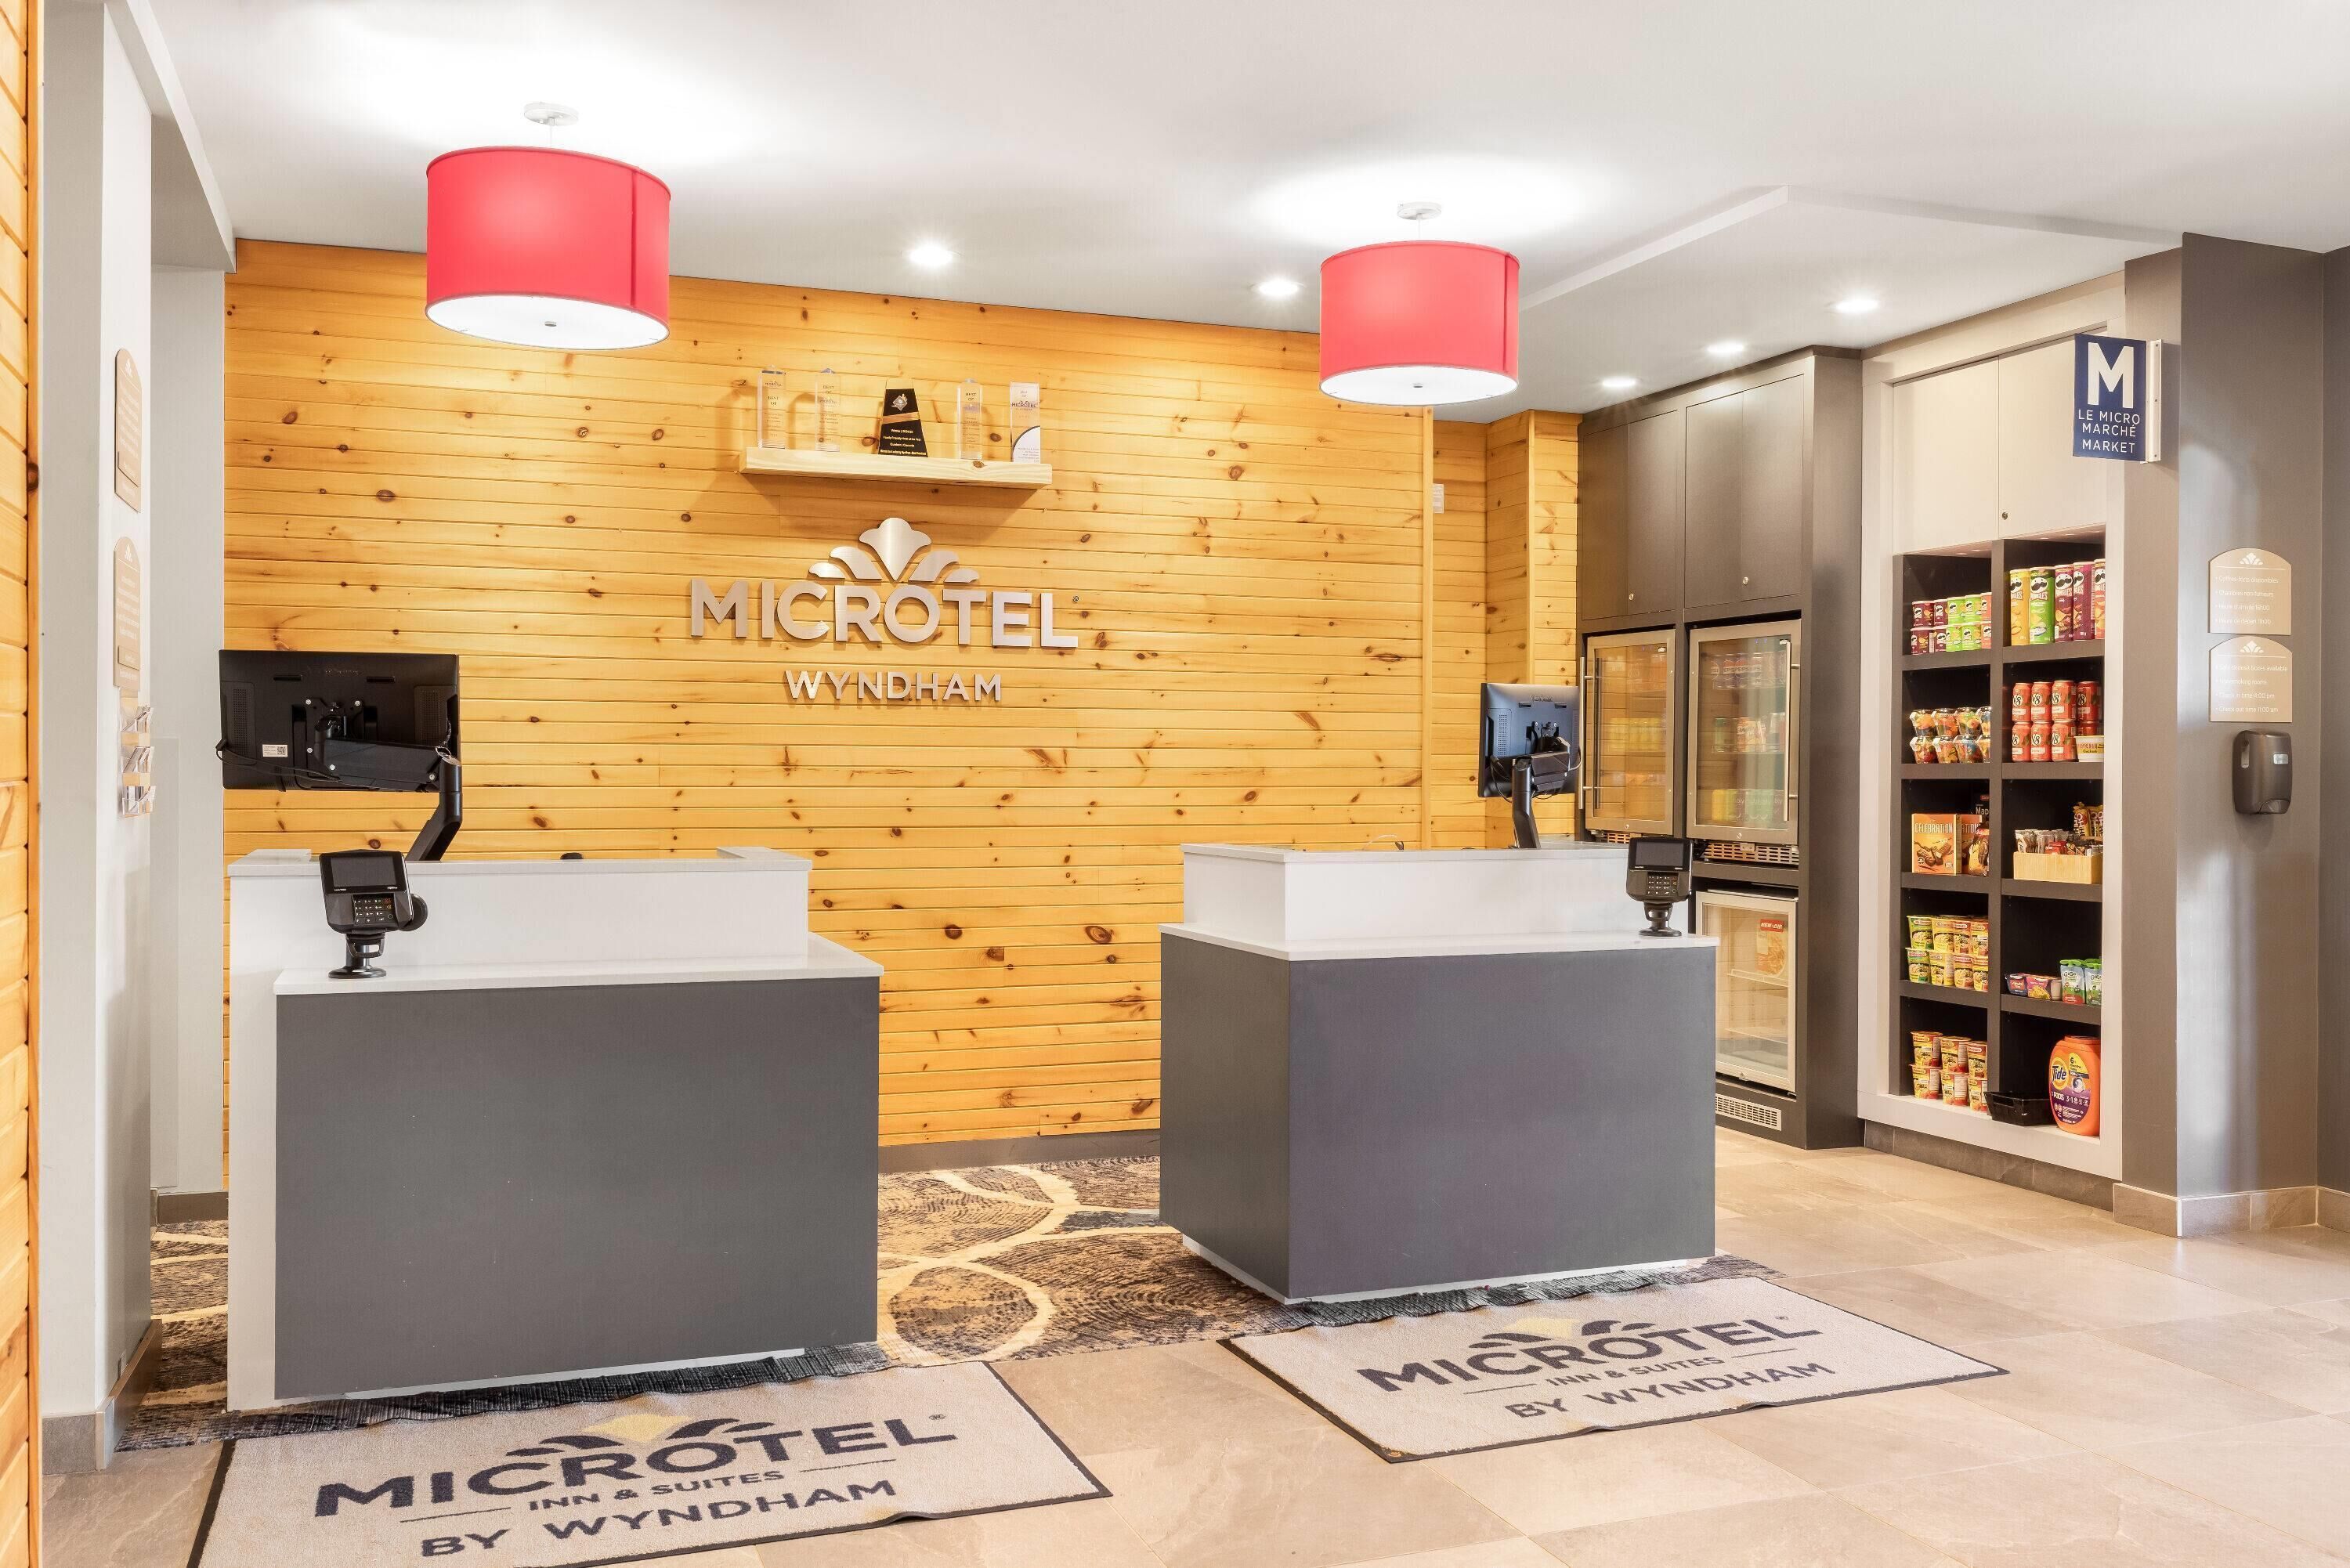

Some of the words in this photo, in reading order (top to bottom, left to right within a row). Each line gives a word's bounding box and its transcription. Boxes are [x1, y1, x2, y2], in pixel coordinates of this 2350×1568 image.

[2087, 341, 2135, 409] M
[2078, 409, 2094, 421] LE
[2099, 410, 2141, 425] MICRO
[2082, 422, 2137, 437] MARCHÉ
[2082, 439, 2135, 453] MARKET
[690, 578, 1079, 648] MICROTEL
[785, 670, 1002, 701] WYNDHAM
[2052, 1065, 2067, 1082] Tide
[2053, 1091, 2066, 1102] PODS
[1355, 1319, 1823, 1393] MICROTEL
[1545, 1373, 1601, 1386] INN
[1604, 1370, 1627, 1378] &
[1629, 1357, 1726, 1375] SUITES
[1504, 1398, 1570, 1418] BY
[1582, 1362, 1836, 1405] WYNDHAM
[314, 1418, 957, 1517] MICROTEL
[529, 1493, 602, 1511] INN
[613, 1489, 639, 1501] &
[651, 1470, 785, 1495] SUITES
[421, 1528, 510, 1557] BY
[543, 1479, 897, 1540] WYNDHAM
